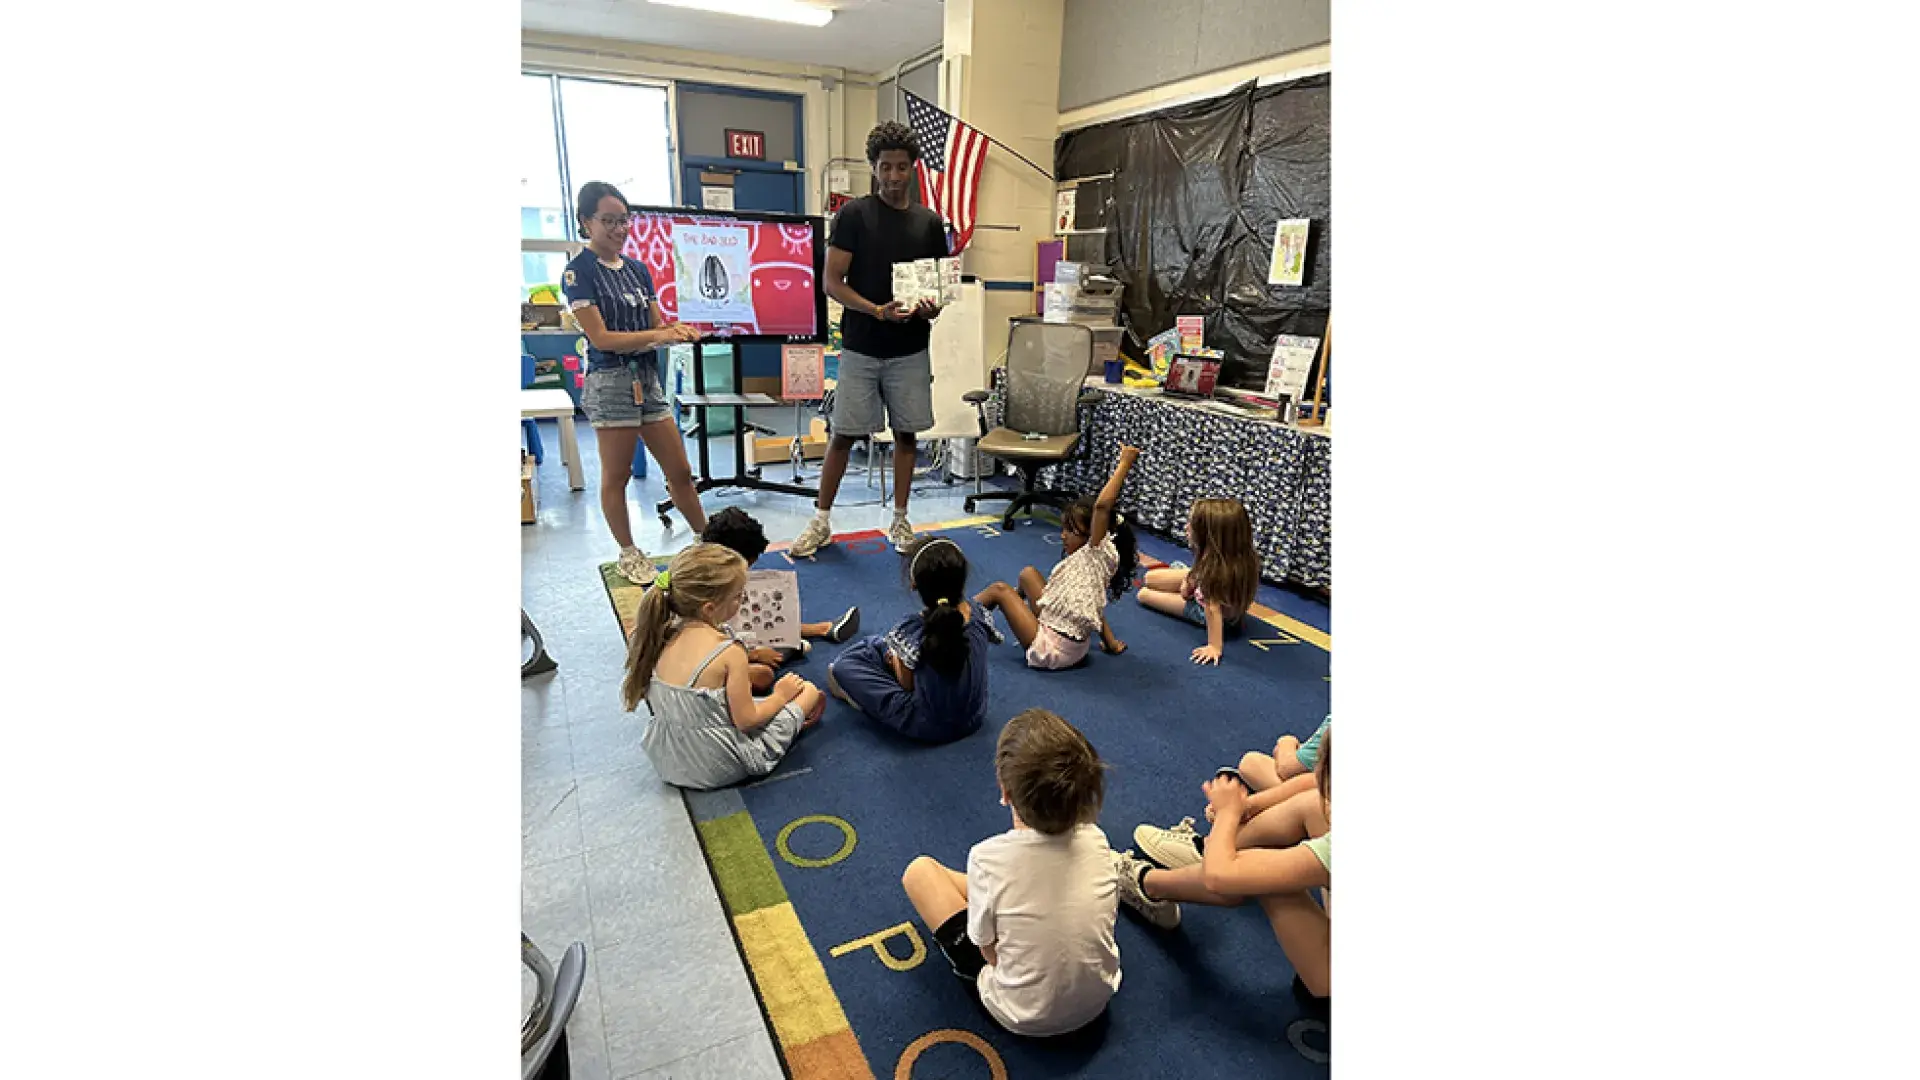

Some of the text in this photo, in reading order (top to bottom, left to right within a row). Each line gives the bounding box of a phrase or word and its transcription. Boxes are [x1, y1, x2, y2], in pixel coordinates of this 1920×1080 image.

[733, 134, 759, 156] EXIT
[775, 814, 858, 868] O
[829, 920, 928, 972] P
